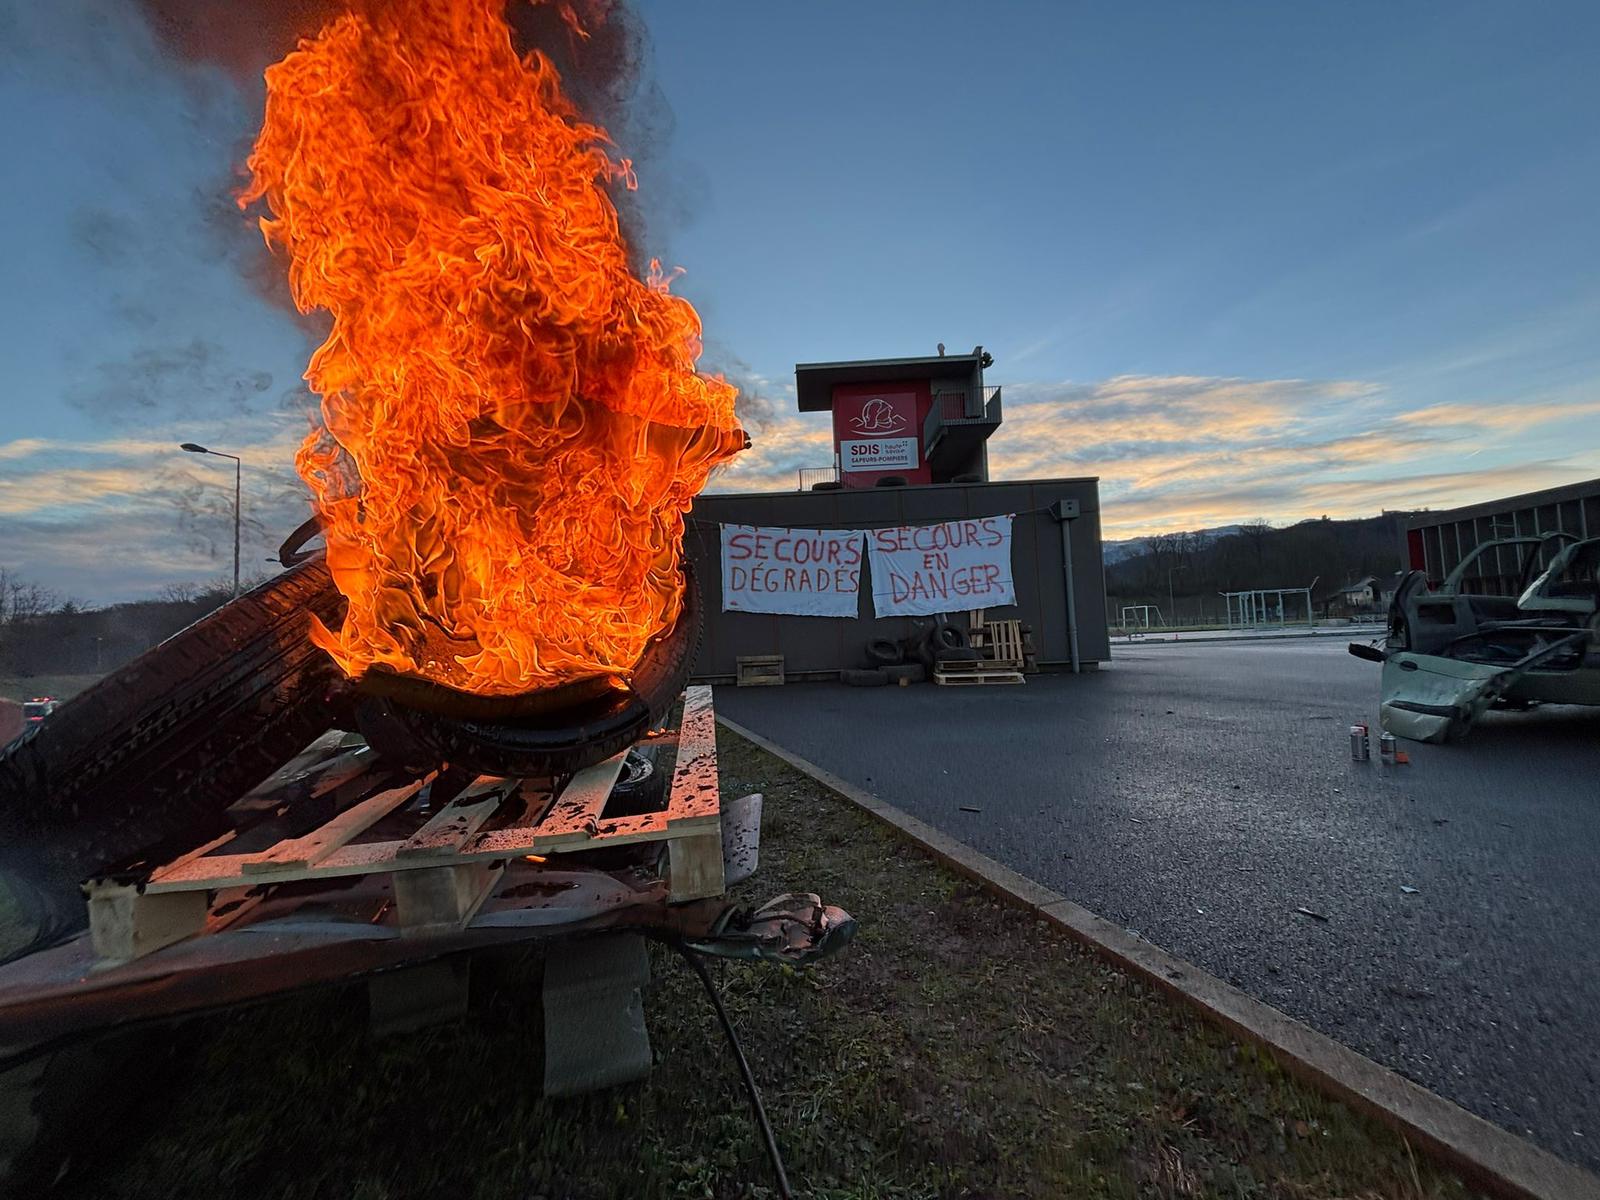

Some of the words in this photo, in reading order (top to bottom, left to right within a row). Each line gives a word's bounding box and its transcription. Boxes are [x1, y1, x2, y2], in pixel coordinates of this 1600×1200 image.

[851, 443, 880, 455] SDIS
[729, 534, 861, 565] SECOURS
[877, 520, 1002, 553] SECOURS
[923, 552, 949, 571] EN
[730, 562, 860, 593] DÉGRADÉS
[890, 565, 1004, 604] DANGER
